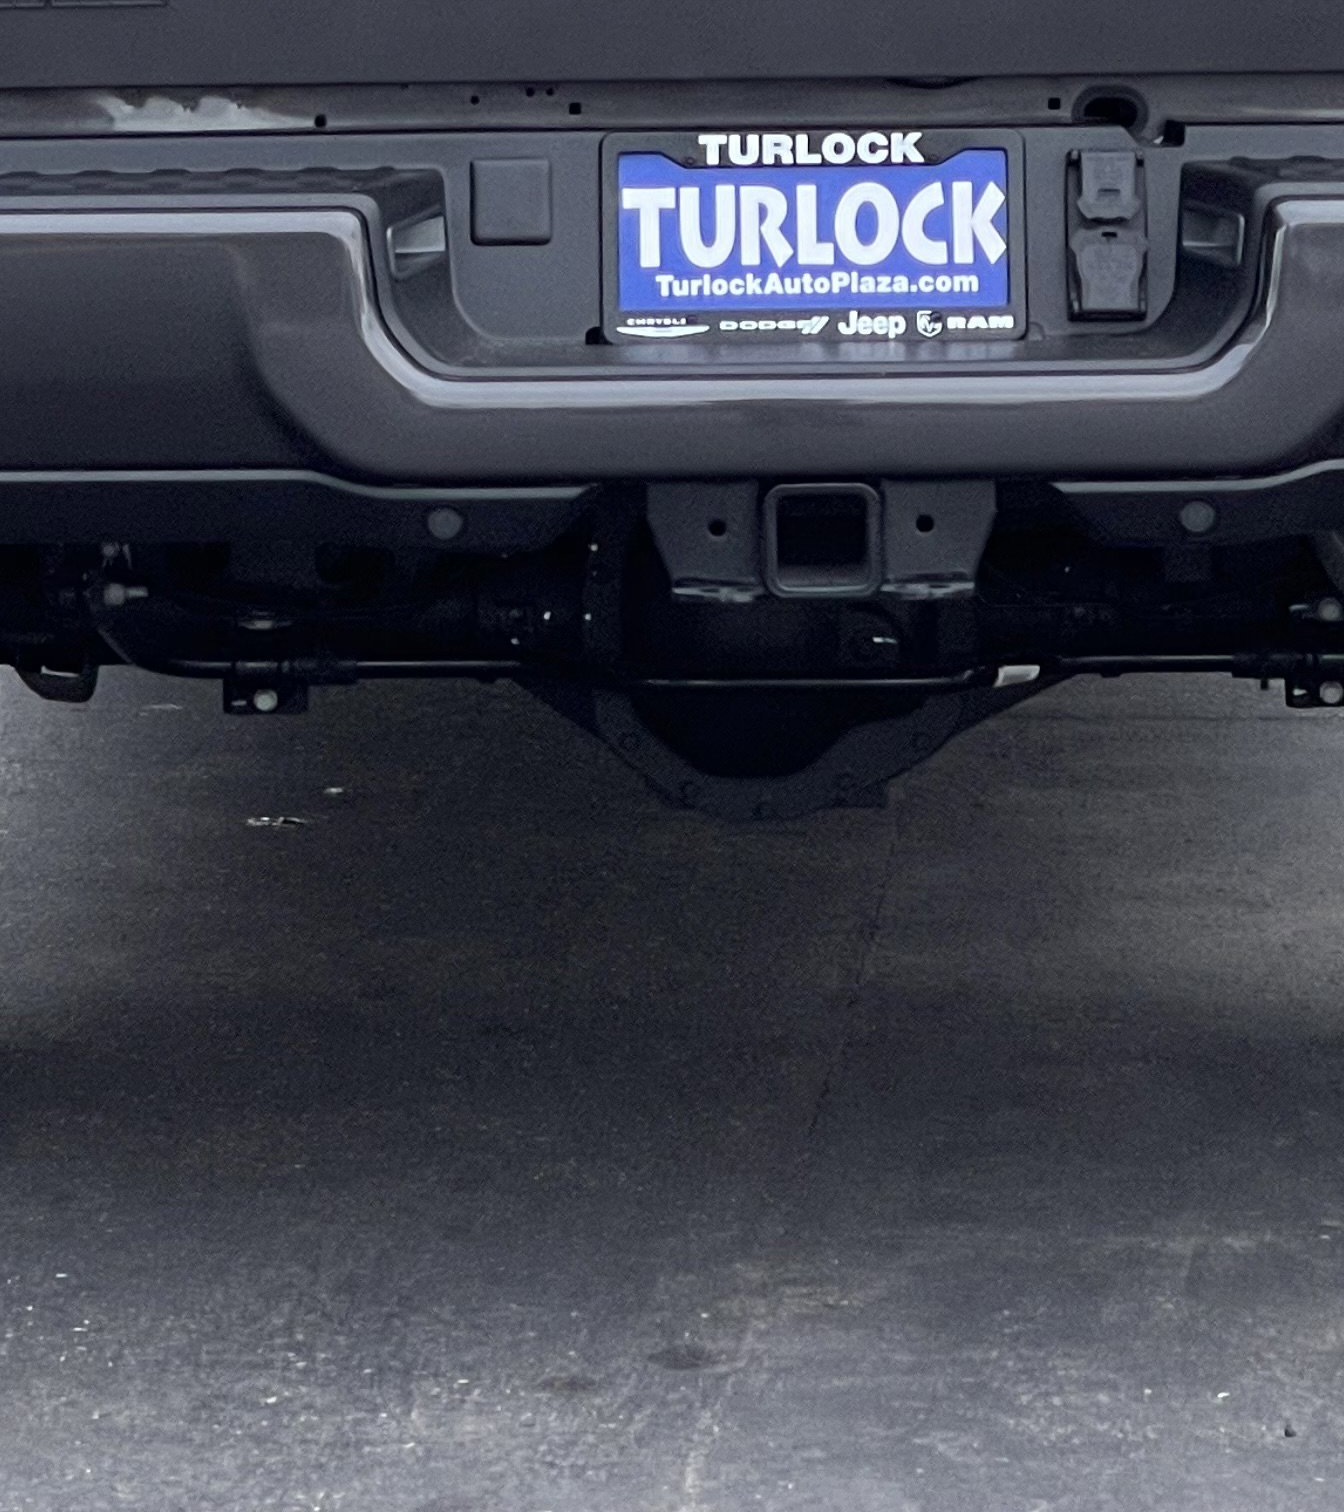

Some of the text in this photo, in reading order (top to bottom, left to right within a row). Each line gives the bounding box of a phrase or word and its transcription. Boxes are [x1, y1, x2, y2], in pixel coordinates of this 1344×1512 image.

[698, 132, 924, 165] TURLOCK
[622, 181, 1007, 267] TURLOCK
[656, 271, 979, 297] TurlockAutoPlaza.com
[719, 319, 812, 330] DODGE
[837, 309, 907, 339] Jeep
[946, 315, 1015, 330] RAM
